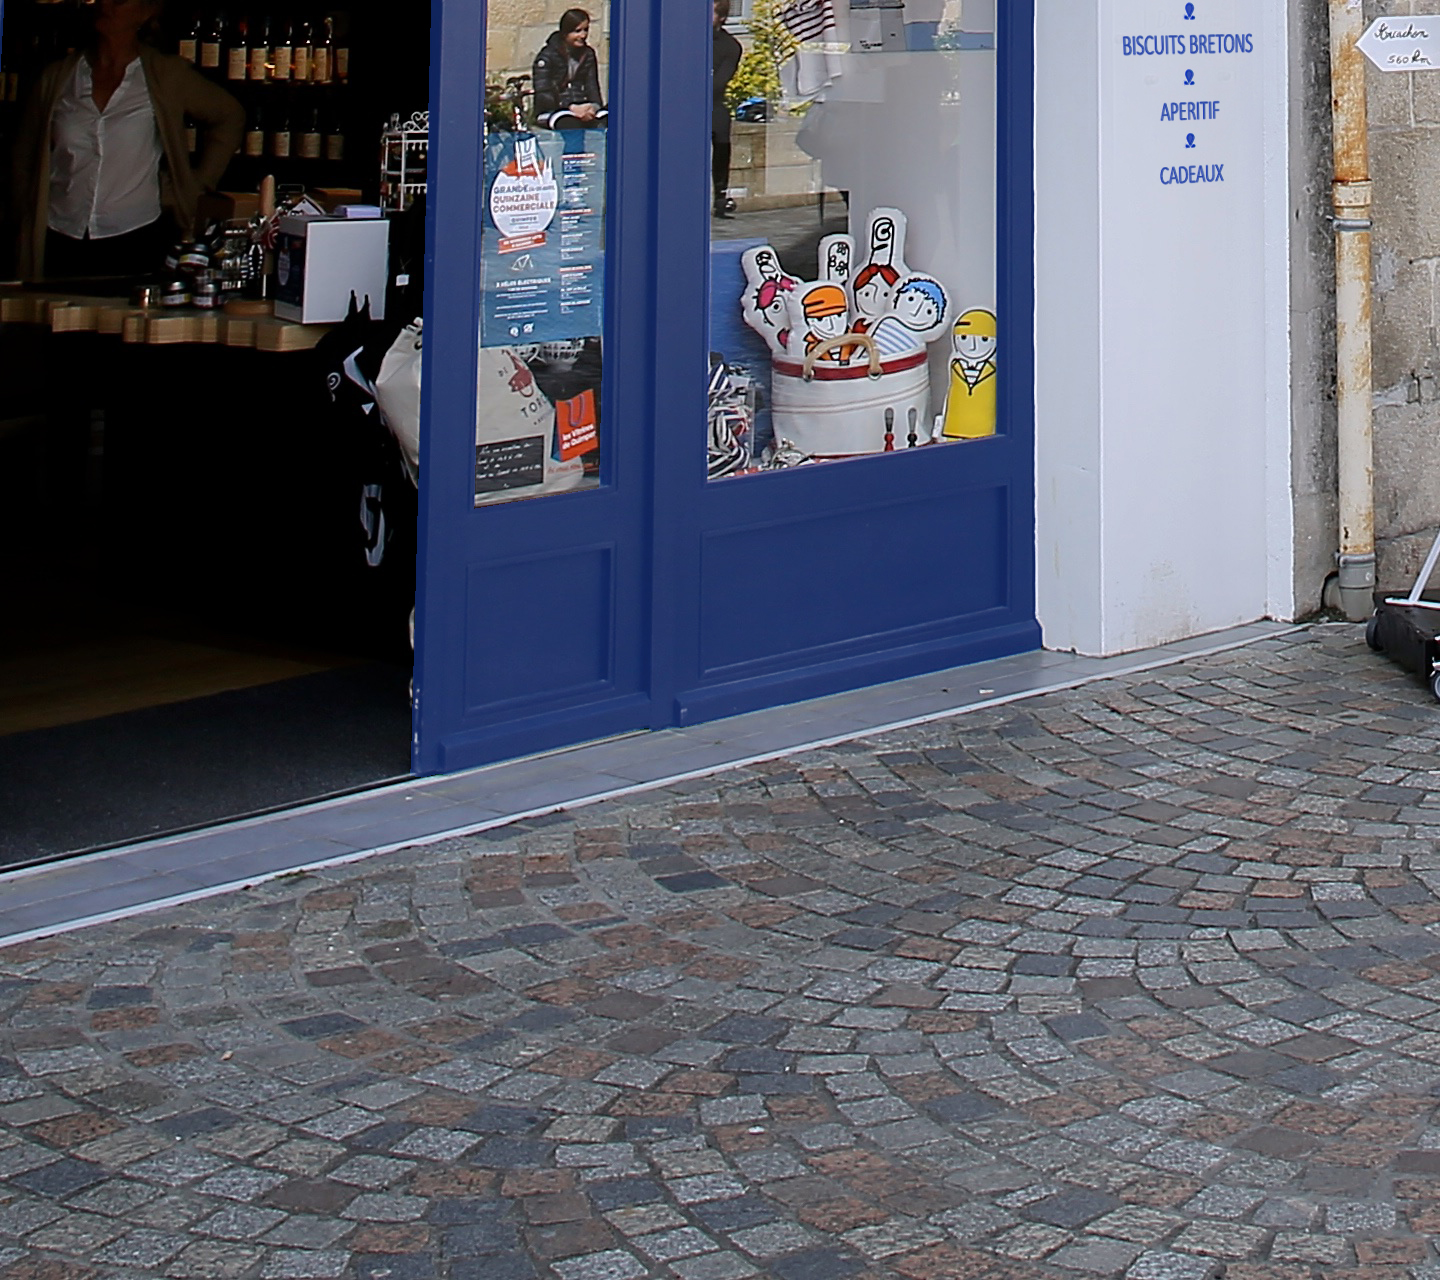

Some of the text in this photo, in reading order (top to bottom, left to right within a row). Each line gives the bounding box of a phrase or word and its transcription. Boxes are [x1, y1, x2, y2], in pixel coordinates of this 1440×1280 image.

[1123, 34, 1253, 56] BISCUITS BRETONS
[1161, 101, 1220, 121] APERITIF
[1160, 164, 1224, 185] CADEAUX
[494, 184, 528, 194] GRANDE
[493, 193, 540, 204] QUINZAINE
[493, 201, 555, 213] COMMERCIALE
